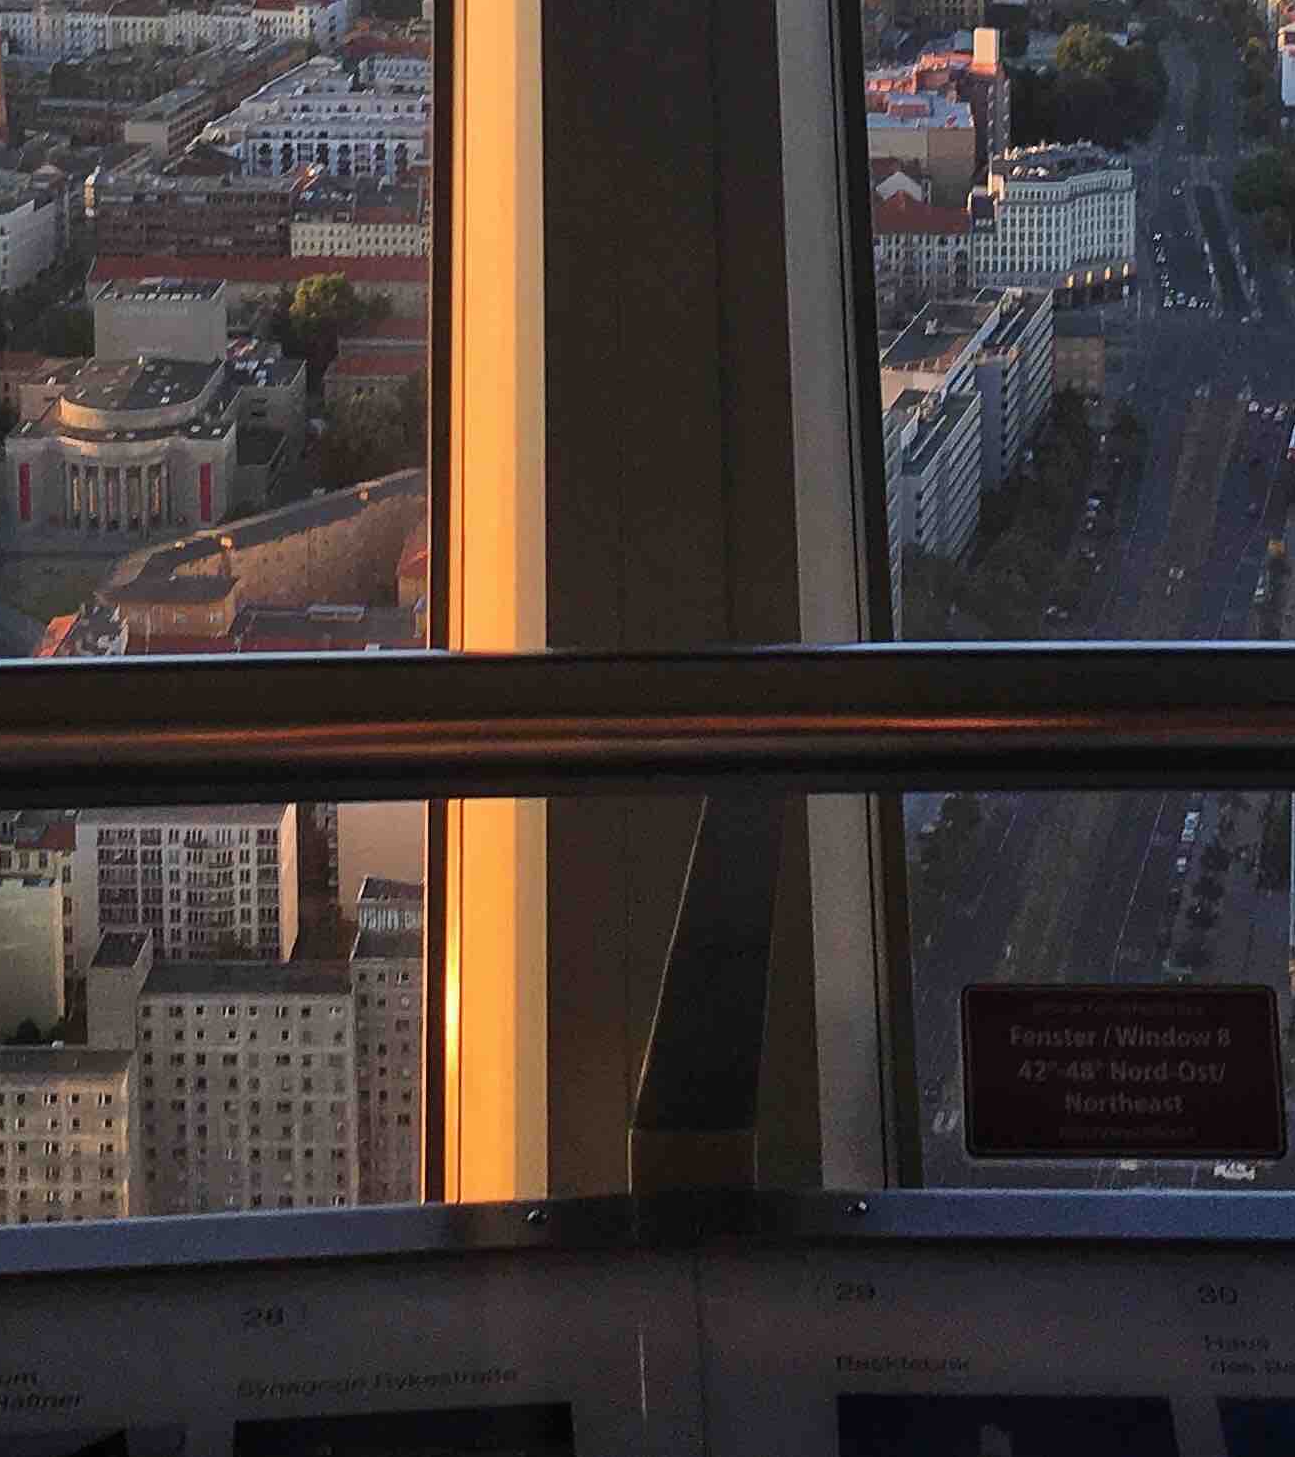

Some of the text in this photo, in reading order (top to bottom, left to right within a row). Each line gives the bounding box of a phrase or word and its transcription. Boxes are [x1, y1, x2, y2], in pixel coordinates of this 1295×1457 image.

[1009, 1024, 1096, 1047] Fenster
[1115, 1025, 1211, 1048] Window
[1110, 1060, 1226, 1083] Nord-Ost/
[1064, 1092, 1183, 1114] Northeast
[1197, 1284, 1238, 1305] 30
